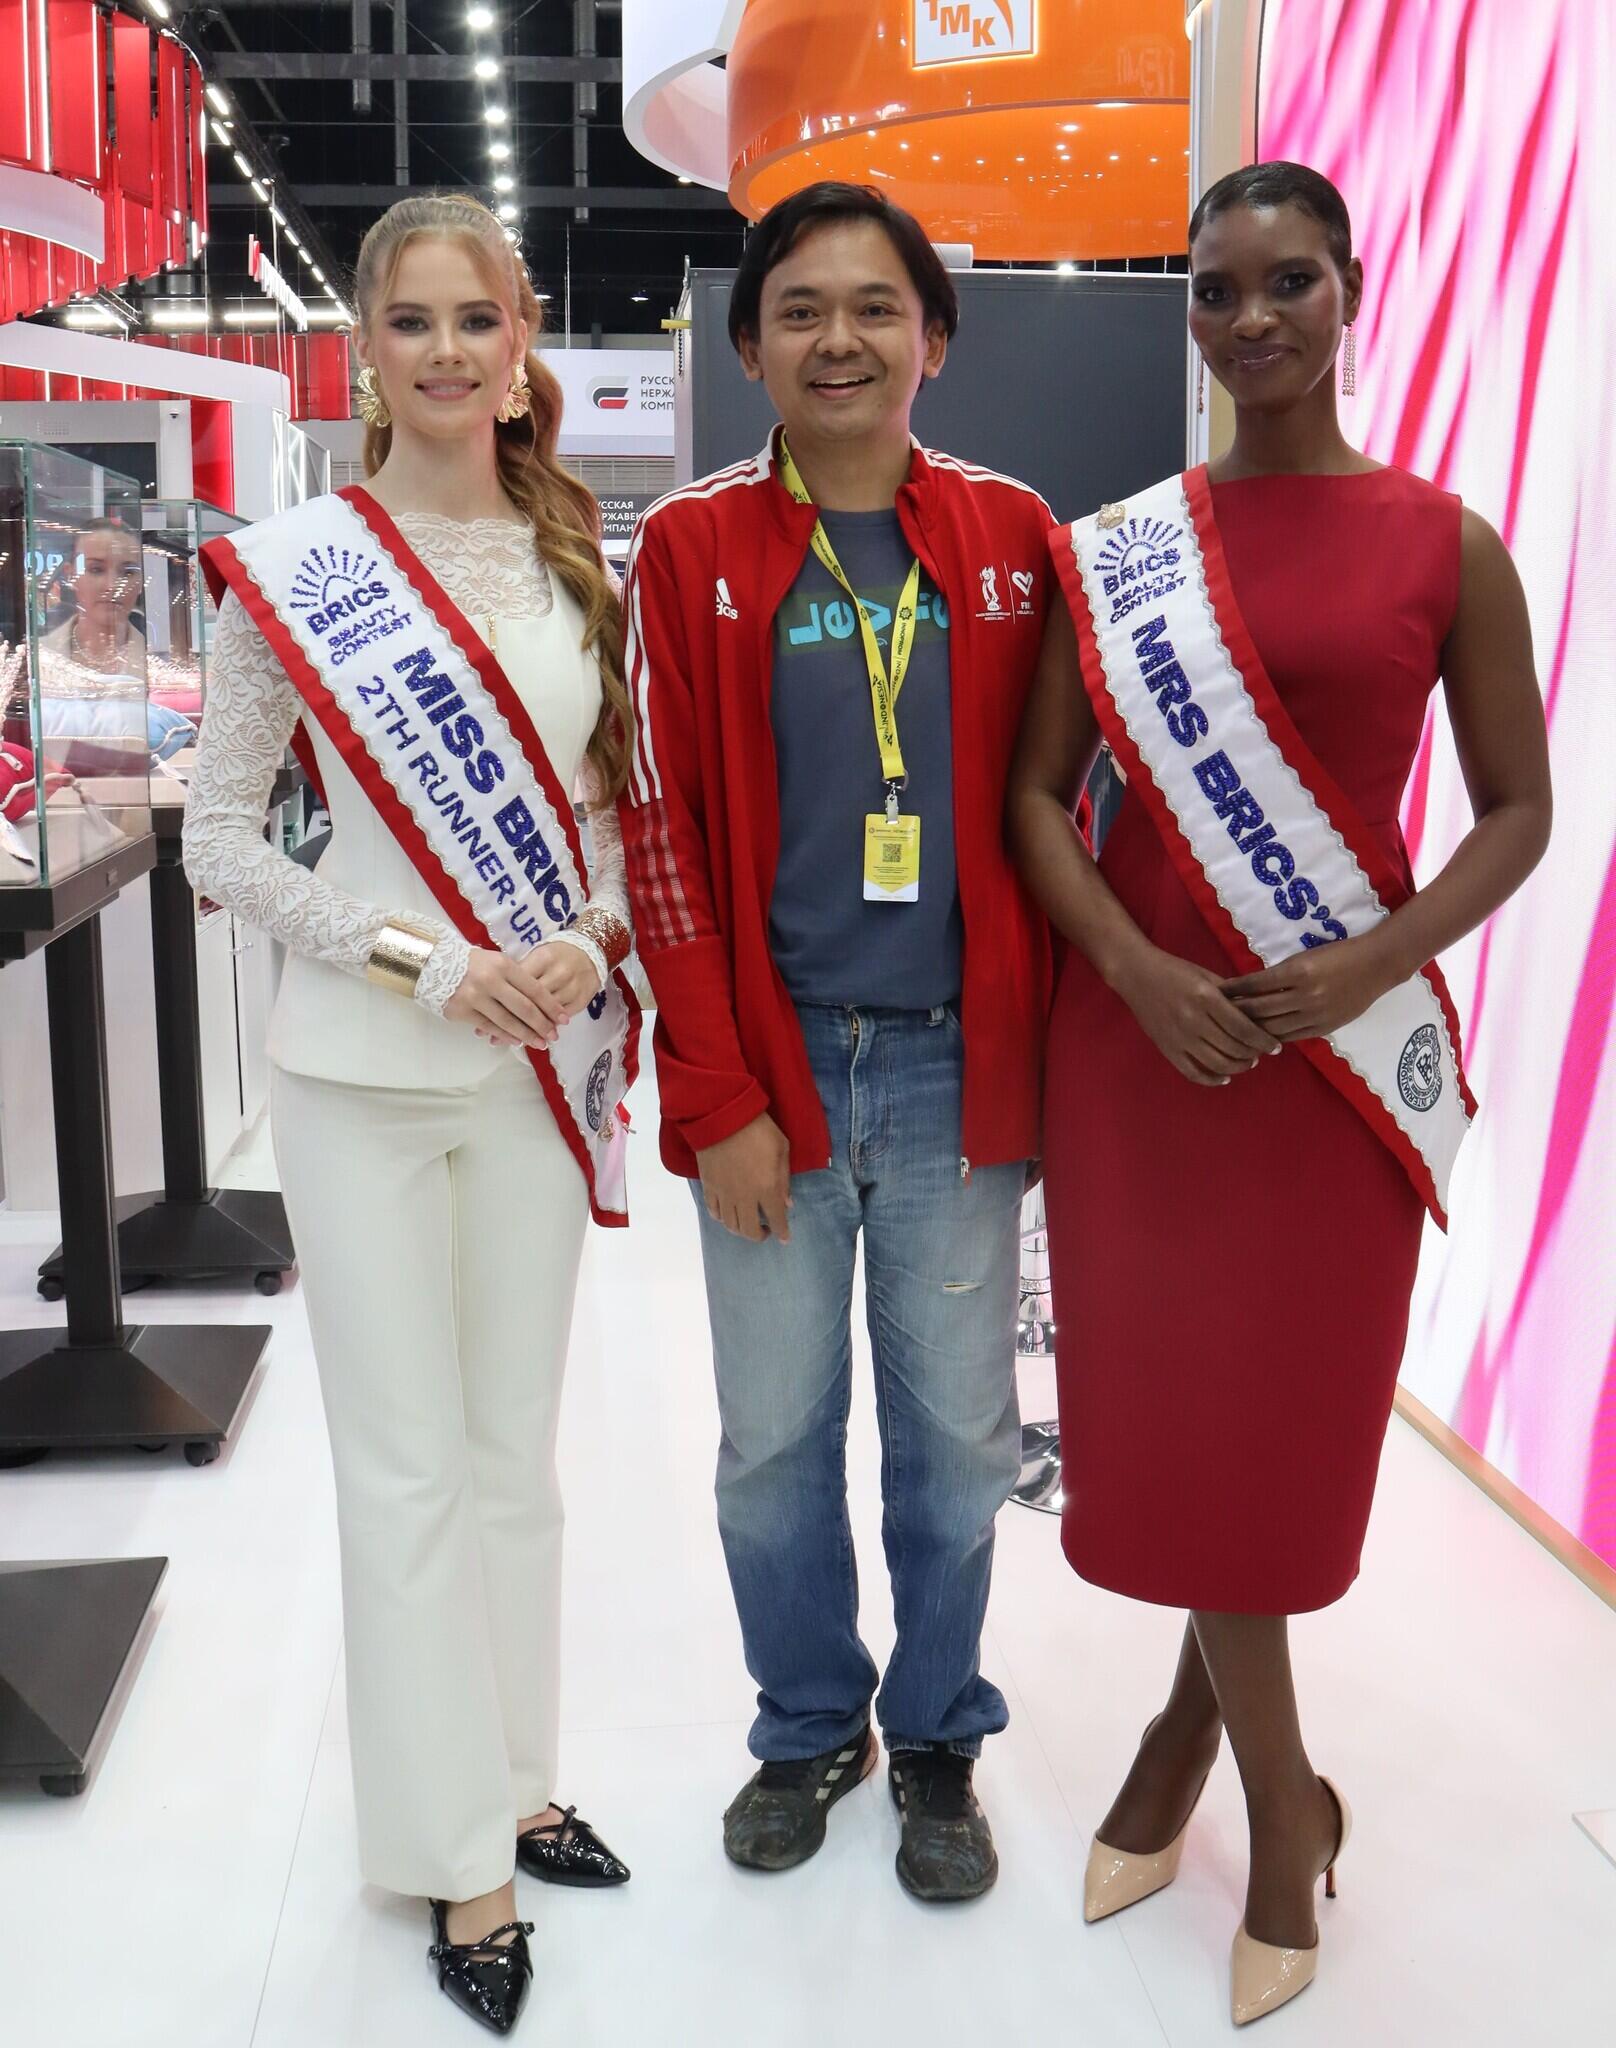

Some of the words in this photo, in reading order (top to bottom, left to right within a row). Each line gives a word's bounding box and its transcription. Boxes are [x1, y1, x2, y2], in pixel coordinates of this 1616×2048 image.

[1103, 547, 1181, 597] BRICS
[306, 580, 390, 636] BRICS
[327, 604, 396, 650] BEAUTY
[1110, 575, 1186, 625] CONTEST
[330, 612, 412, 666] CONTEST
[1131, 614, 1208, 748] MRS
[355, 674, 420, 751] 2TH
[393, 646, 505, 795] MISS
[492, 795, 579, 931] BRIC
